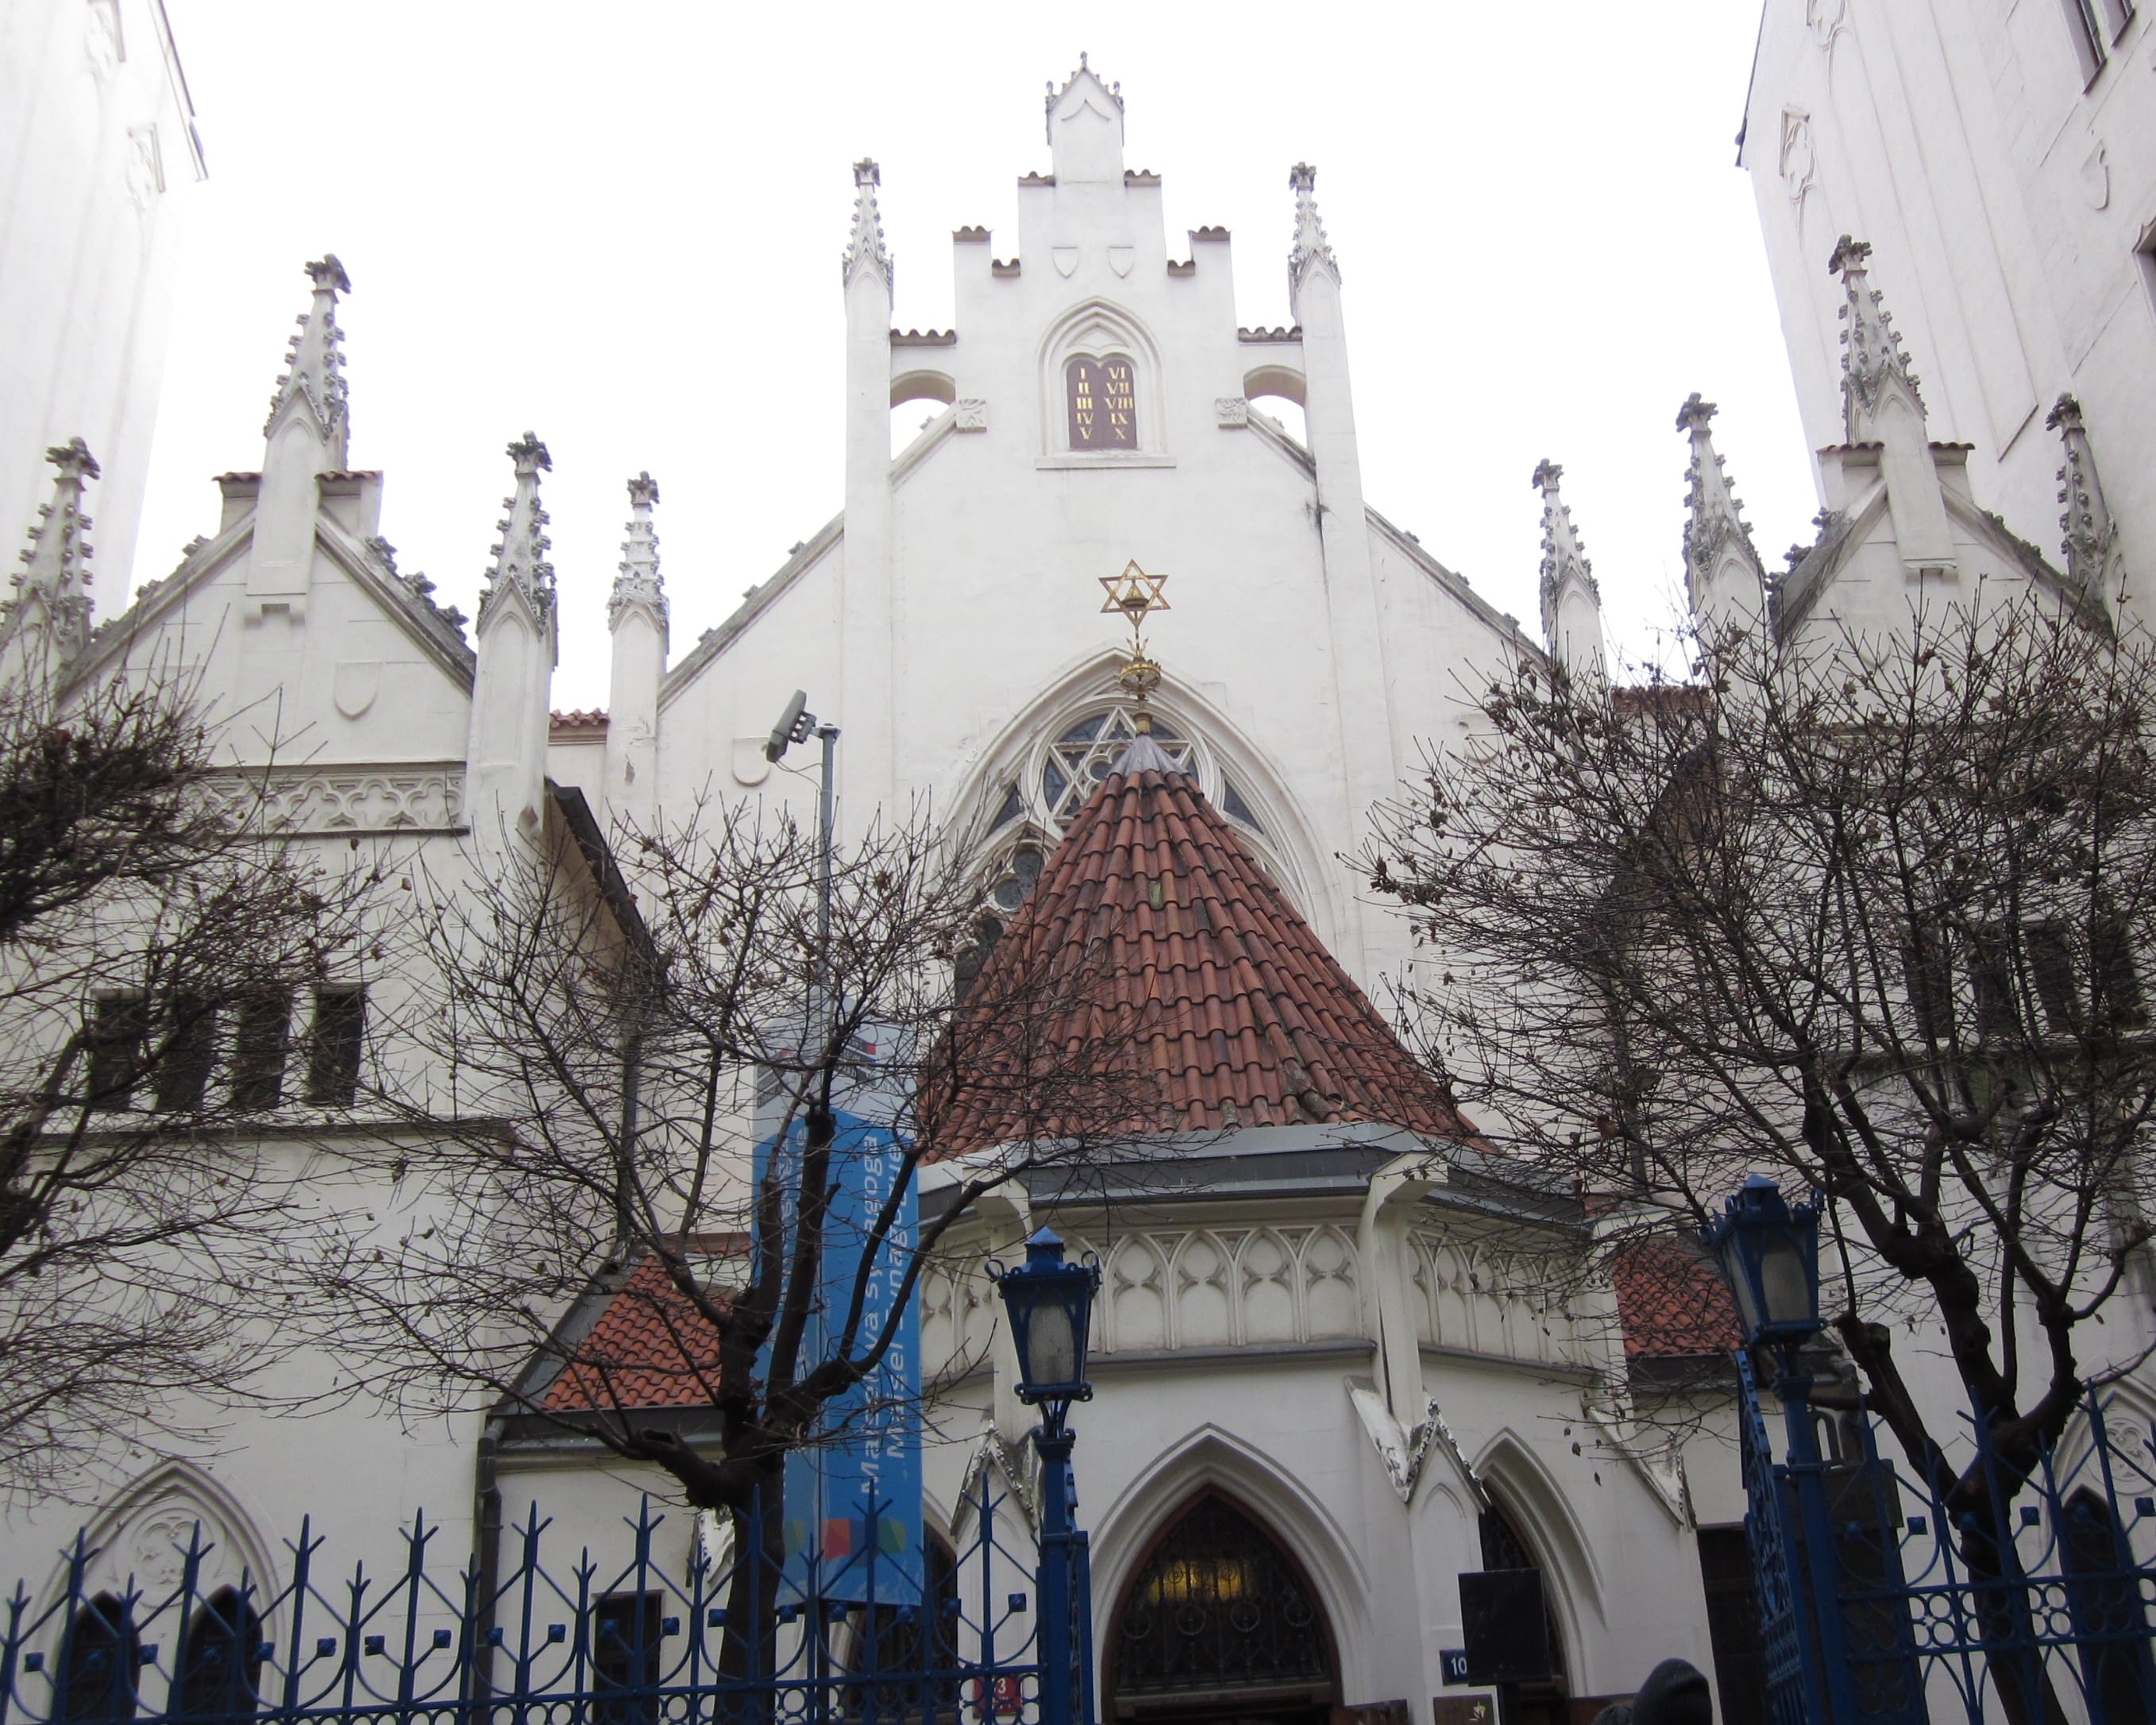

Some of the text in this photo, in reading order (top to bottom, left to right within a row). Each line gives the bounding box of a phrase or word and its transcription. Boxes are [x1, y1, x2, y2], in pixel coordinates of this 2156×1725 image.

[1080, 367, 1086, 380] I
[1108, 367, 1126, 380] VI
[1078, 382, 1090, 395] II
[1106, 382, 1129, 395] VII
[1076, 397, 1093, 409] III
[1105, 397, 1134, 409] VIII
[1076, 412, 1093, 424] IV
[1111, 412, 1128, 424] IX
[1080, 427, 1092, 439] V
[1115, 427, 1126, 439] X
[862, 1136, 882, 1300] syagoga
[885, 1342, 905, 1459] Maisel
[1451, 1657, 1468, 1675] 10
